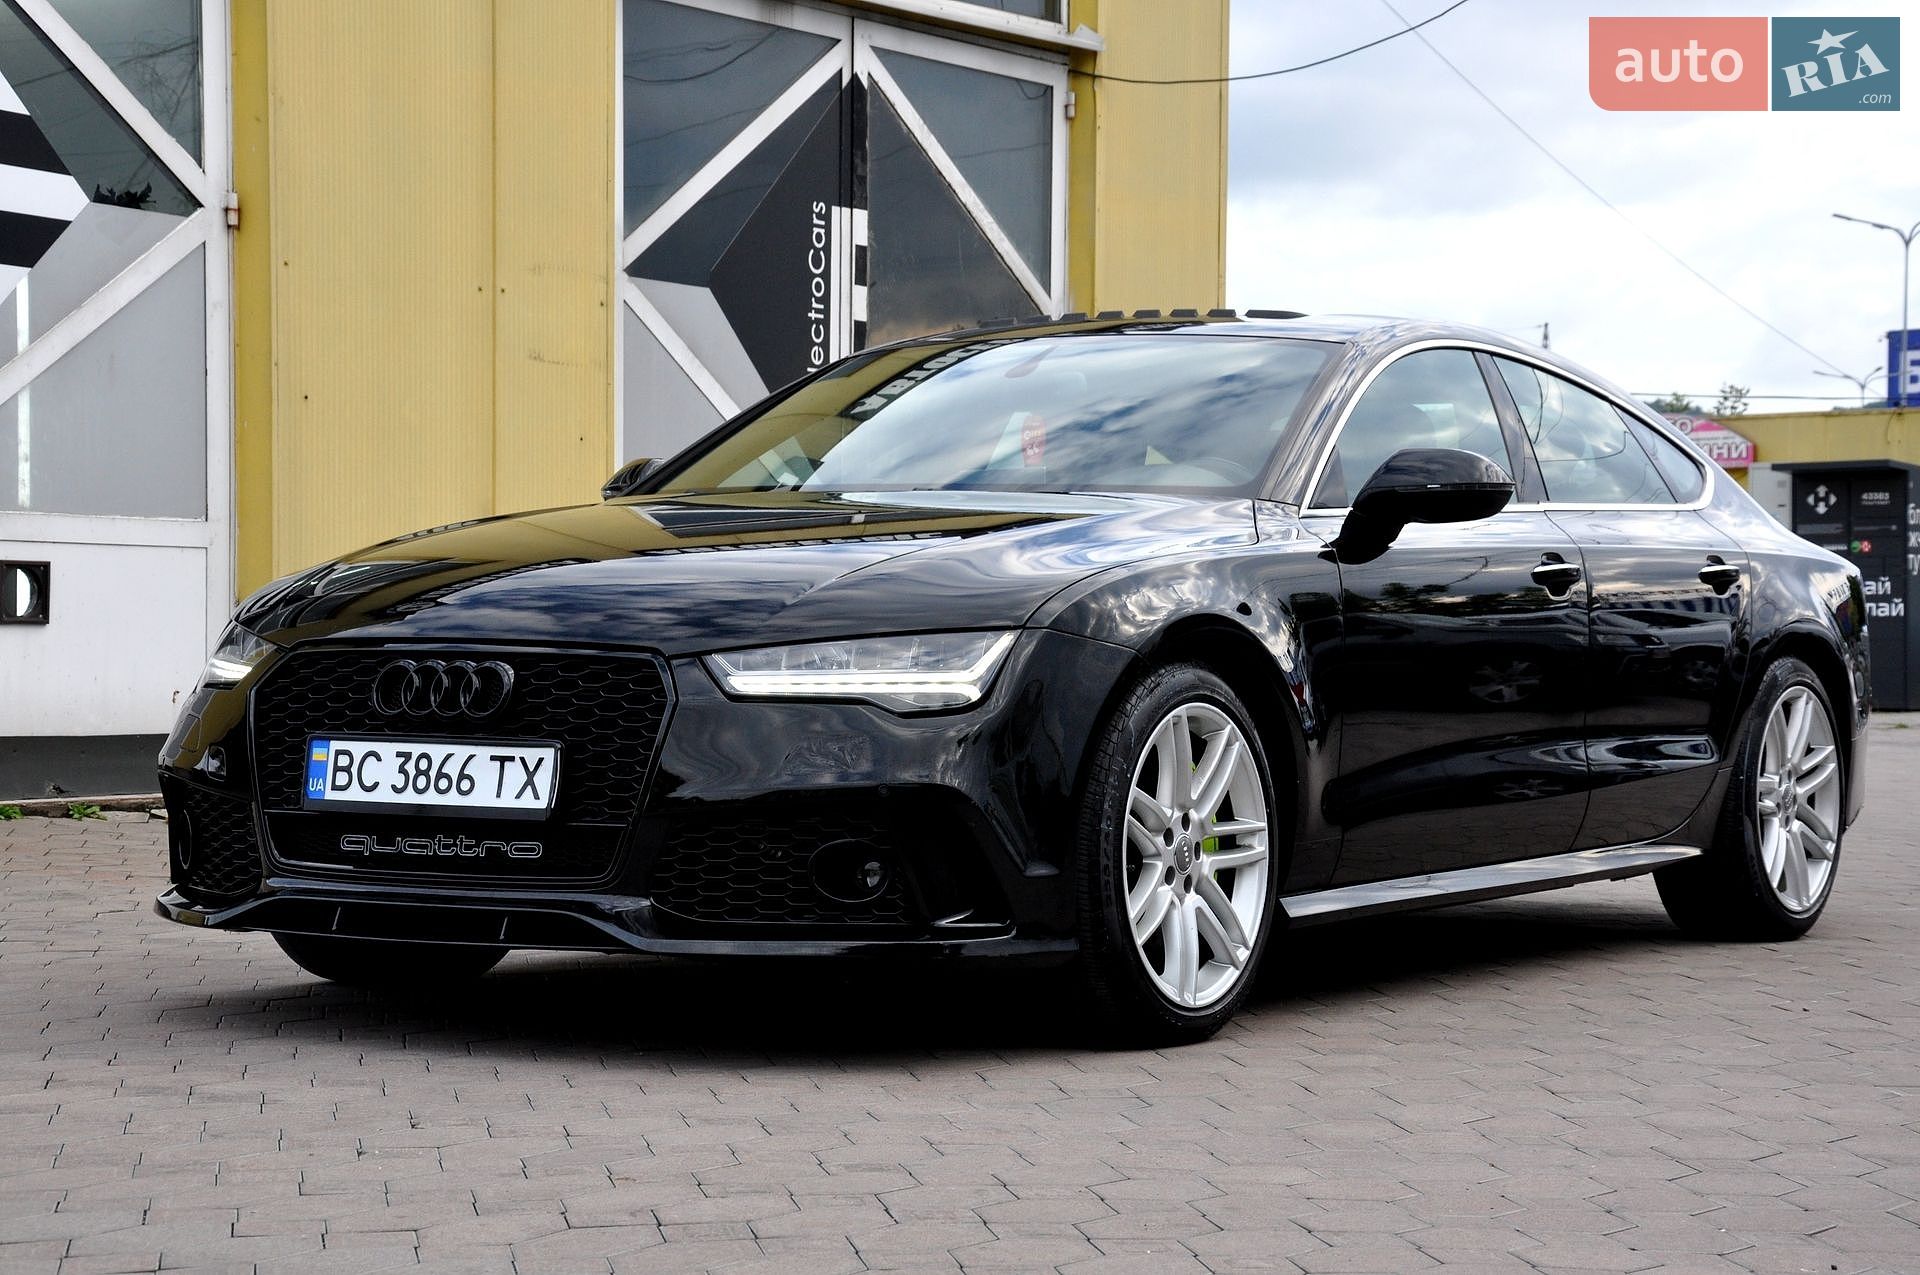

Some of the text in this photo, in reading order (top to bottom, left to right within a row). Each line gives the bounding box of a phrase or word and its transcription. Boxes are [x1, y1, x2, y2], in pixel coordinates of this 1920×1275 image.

[309, 778, 324, 792] UA
[330, 749, 545, 800] BC 3866 TX
[340, 834, 542, 858] quattro
